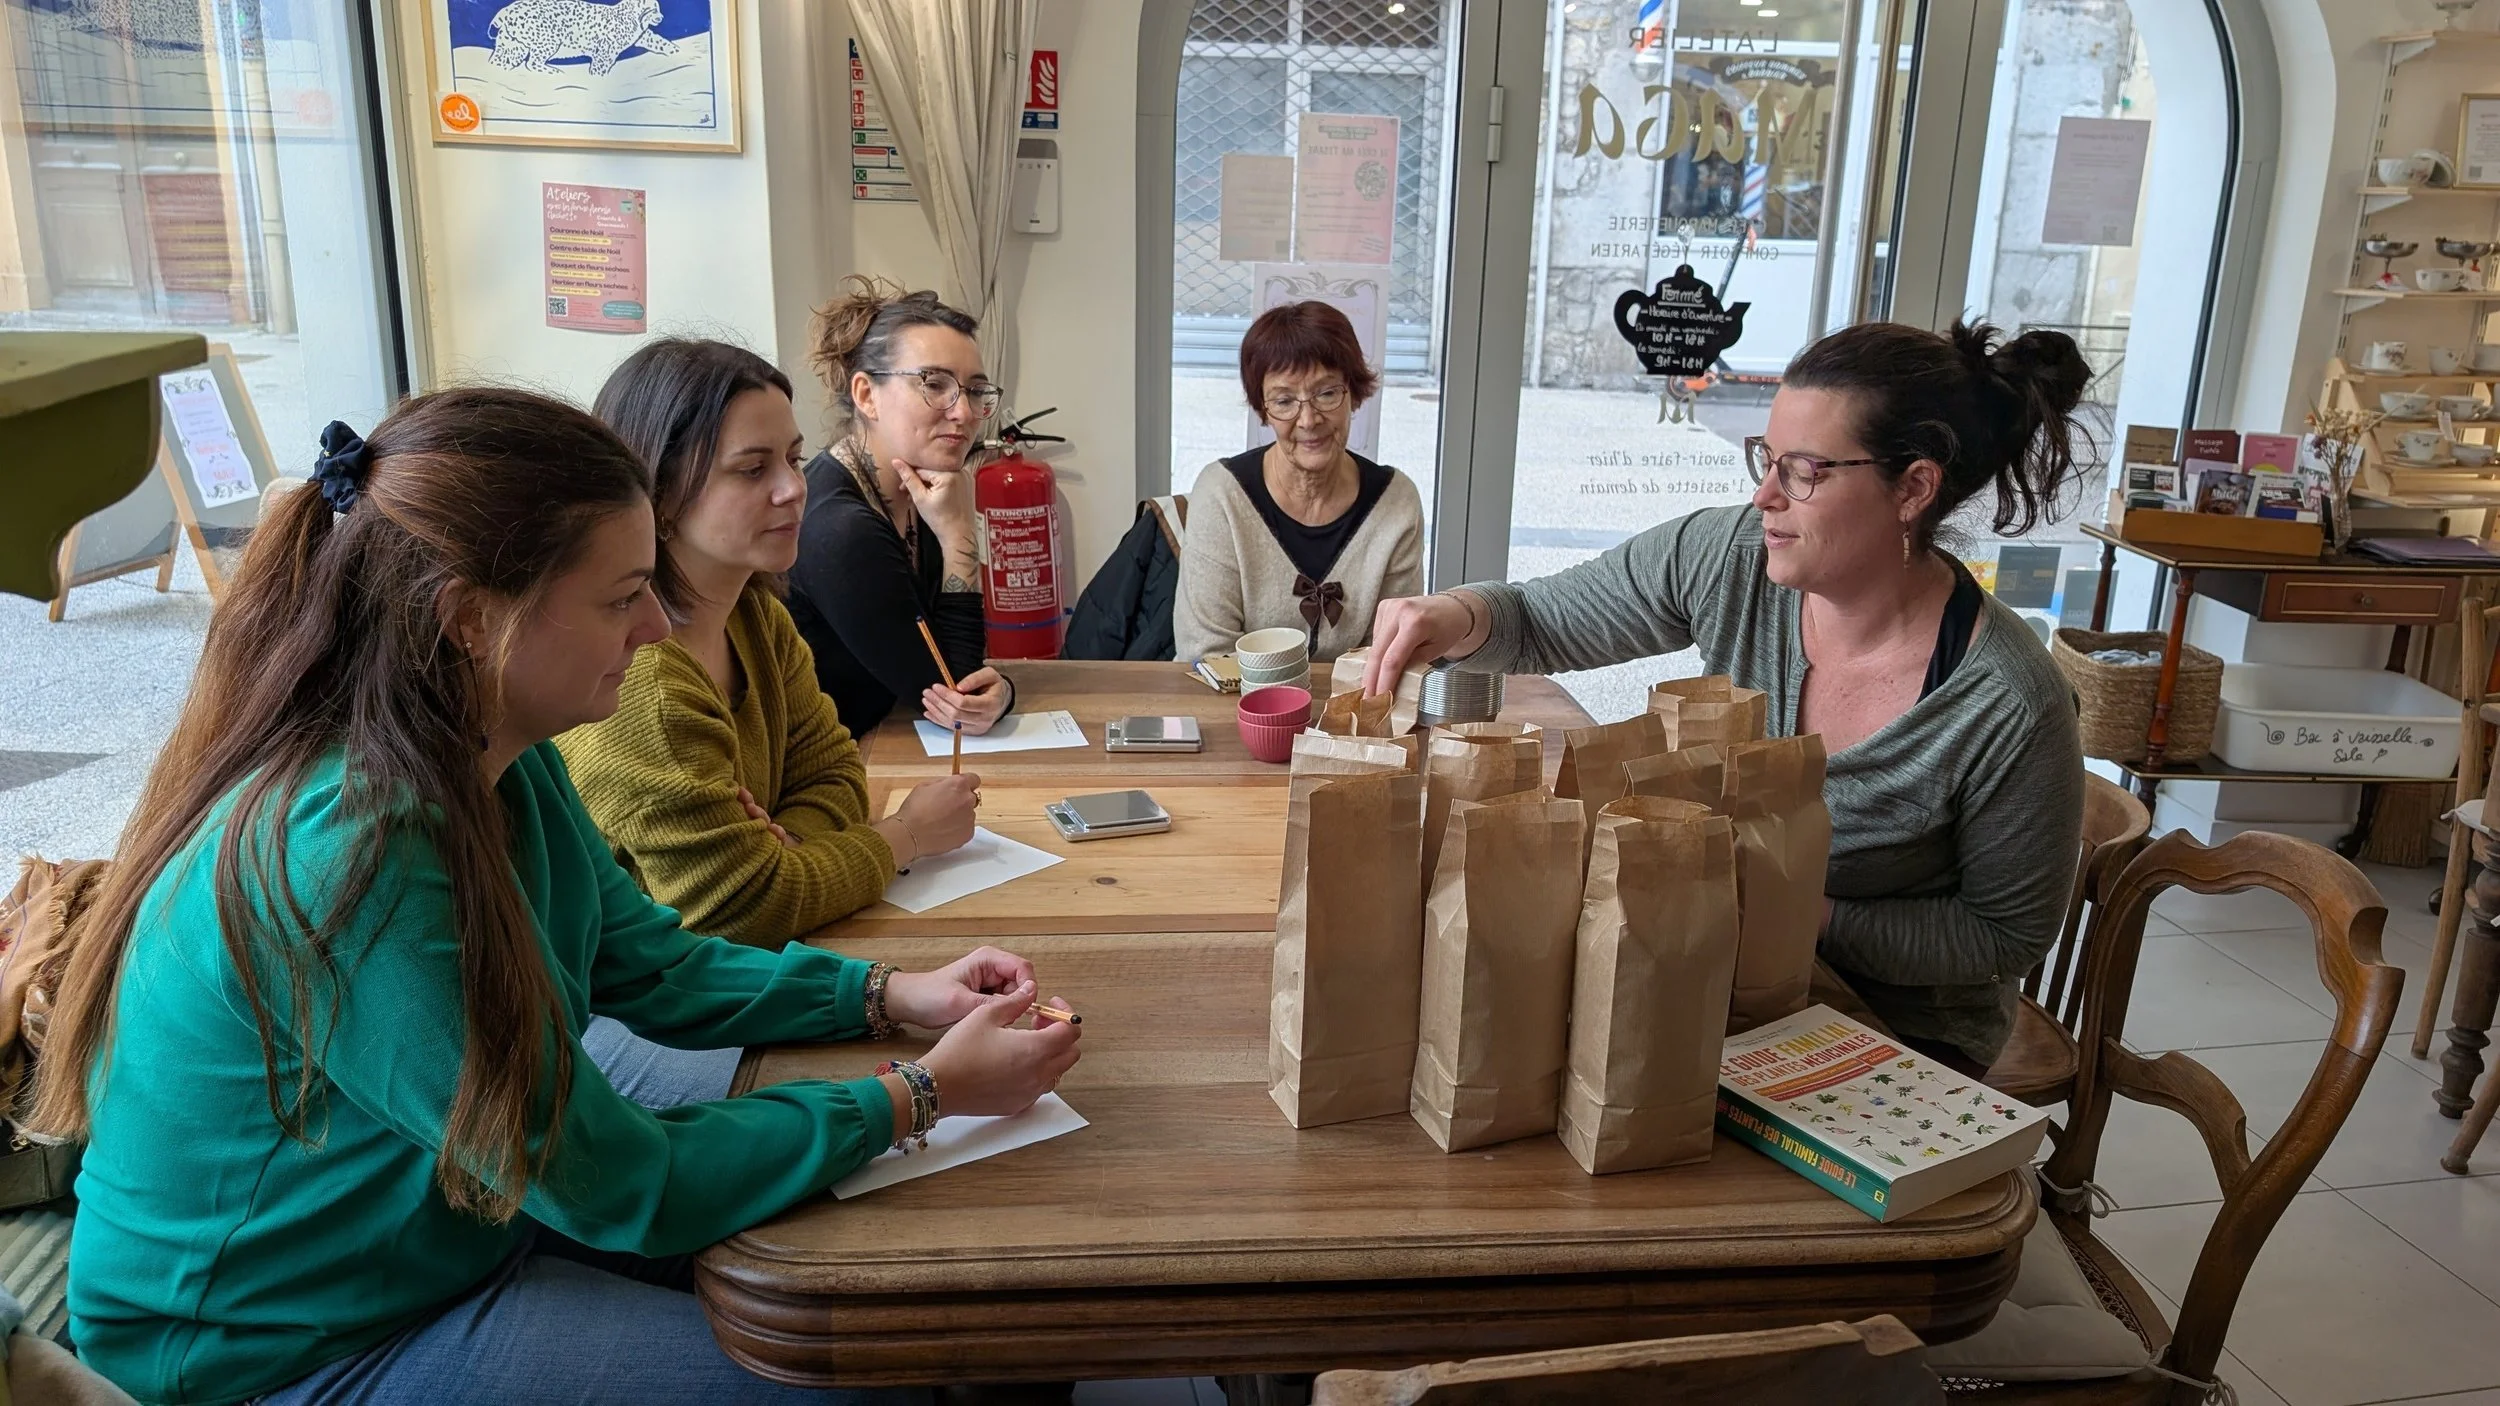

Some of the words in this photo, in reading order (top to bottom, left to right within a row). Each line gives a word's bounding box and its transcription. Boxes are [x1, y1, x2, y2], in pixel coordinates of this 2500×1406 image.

[546, 186, 592, 204] Ateliers
[1661, 284, 1705, 304] Fermé
[990, 507, 1045, 517] EXTINCTEUR
[2294, 727, 2322, 746] Bac
[2332, 729, 2344, 744] à
[1727, 1047, 1788, 1072] GUIDE
[1774, 1021, 1859, 1058] FAMILIAL
[1730, 1070, 1761, 1087] DES
[1759, 1058, 1809, 1082] PLANTES
[1800, 1033, 1877, 1067] MÉDICINALES
[1728, 1105, 1764, 1136] PLANTES
[1762, 1126, 1780, 1143] DES
[1780, 1133, 1819, 1167] FAMILIAL
[1817, 1156, 1845, 1184] GUIDE
[1843, 1168, 1858, 1189] LE
